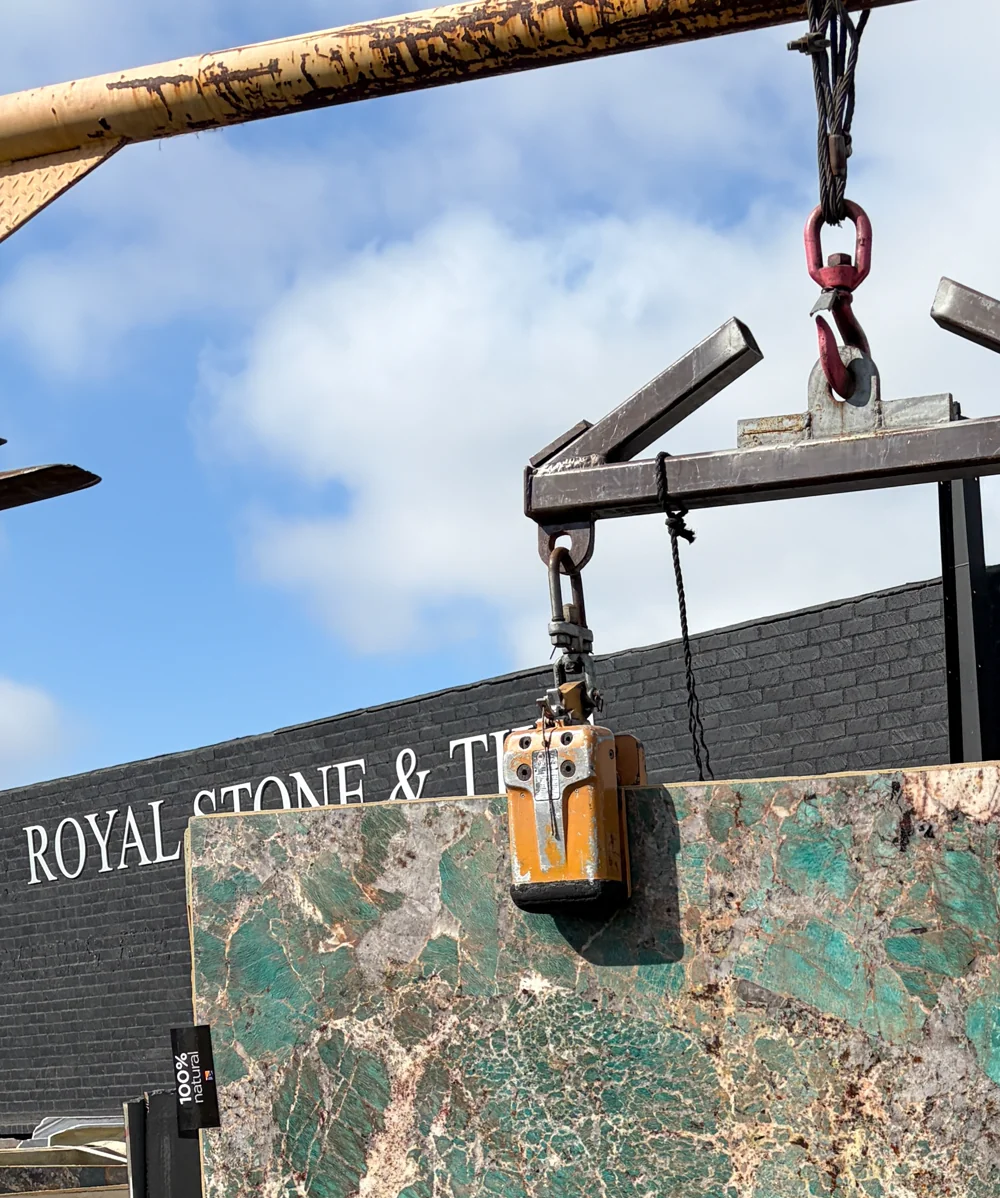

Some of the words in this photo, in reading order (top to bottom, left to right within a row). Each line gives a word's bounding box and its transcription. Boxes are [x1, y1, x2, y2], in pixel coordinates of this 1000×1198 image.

[22, 800, 181, 885] ROYAL
[390, 748, 431, 800] &
[174, 1052, 192, 1105] 100%
[187, 1051, 204, 1104] natural
